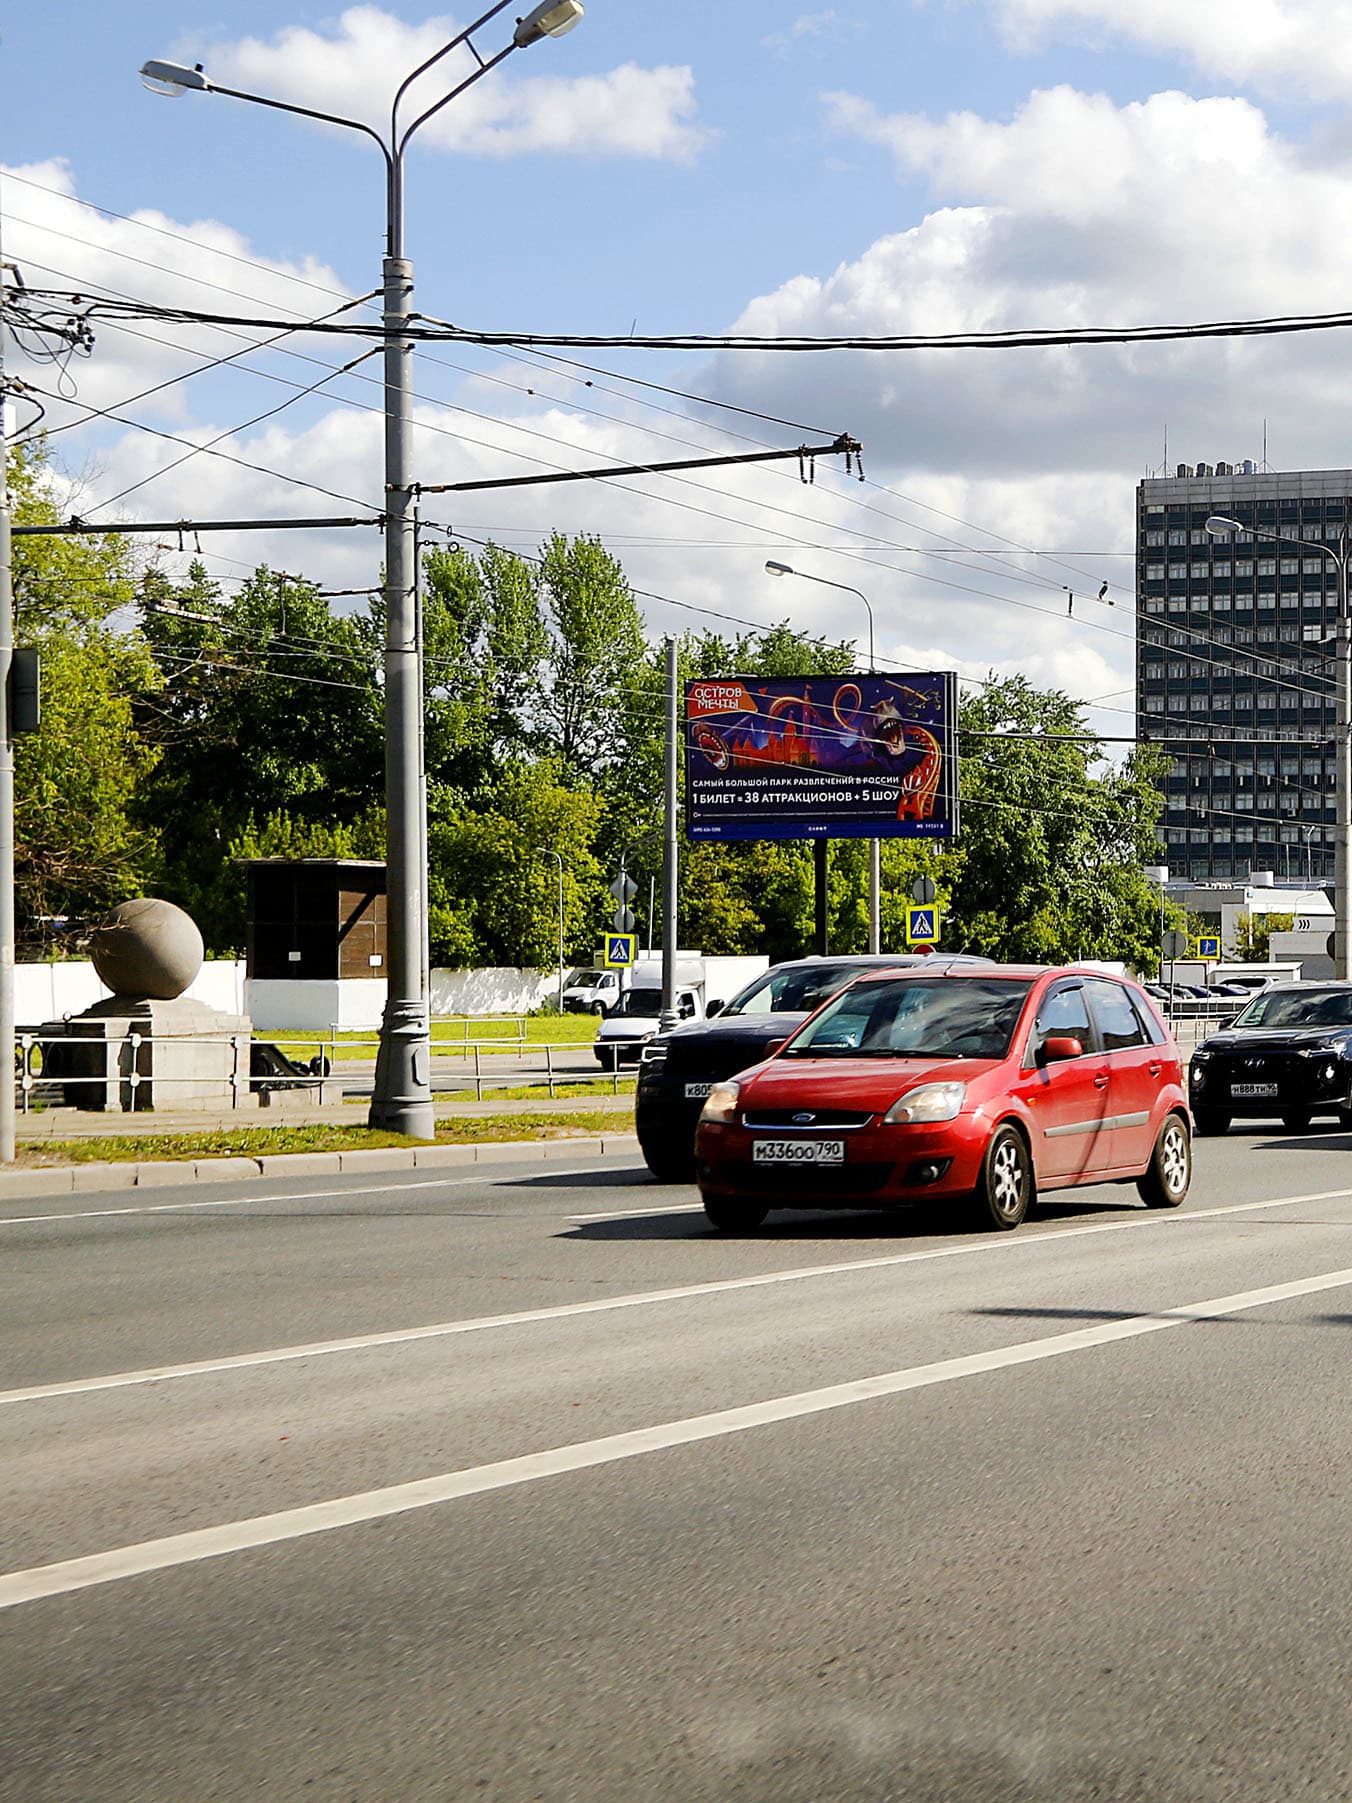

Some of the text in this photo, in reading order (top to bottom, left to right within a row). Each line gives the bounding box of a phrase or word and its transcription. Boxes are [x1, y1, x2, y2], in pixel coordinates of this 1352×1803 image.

[694, 687, 742, 698] ОСТРОВ
[697, 699, 738, 709] МЕЧТЫ
[692, 778, 724, 787] САМЫЙ
[725, 777, 768, 787] БОЛЬШОЙ
[769, 778, 792, 787] ПАРК
[793, 776, 854, 786] РАЗВЛЕЧЕНИЙ
[863, 776, 899, 785] РОССИИ
[692, 793, 698, 804] 1
[699, 793, 736, 804] БИЛЕТ
[744, 791, 760, 803] 38
[761, 792, 852, 804] АТТРАКЦИОНОВ
[862, 789, 870, 801] 5
[872, 790, 899, 801] ШОУ
[816, 1142, 840, 1156] 790
